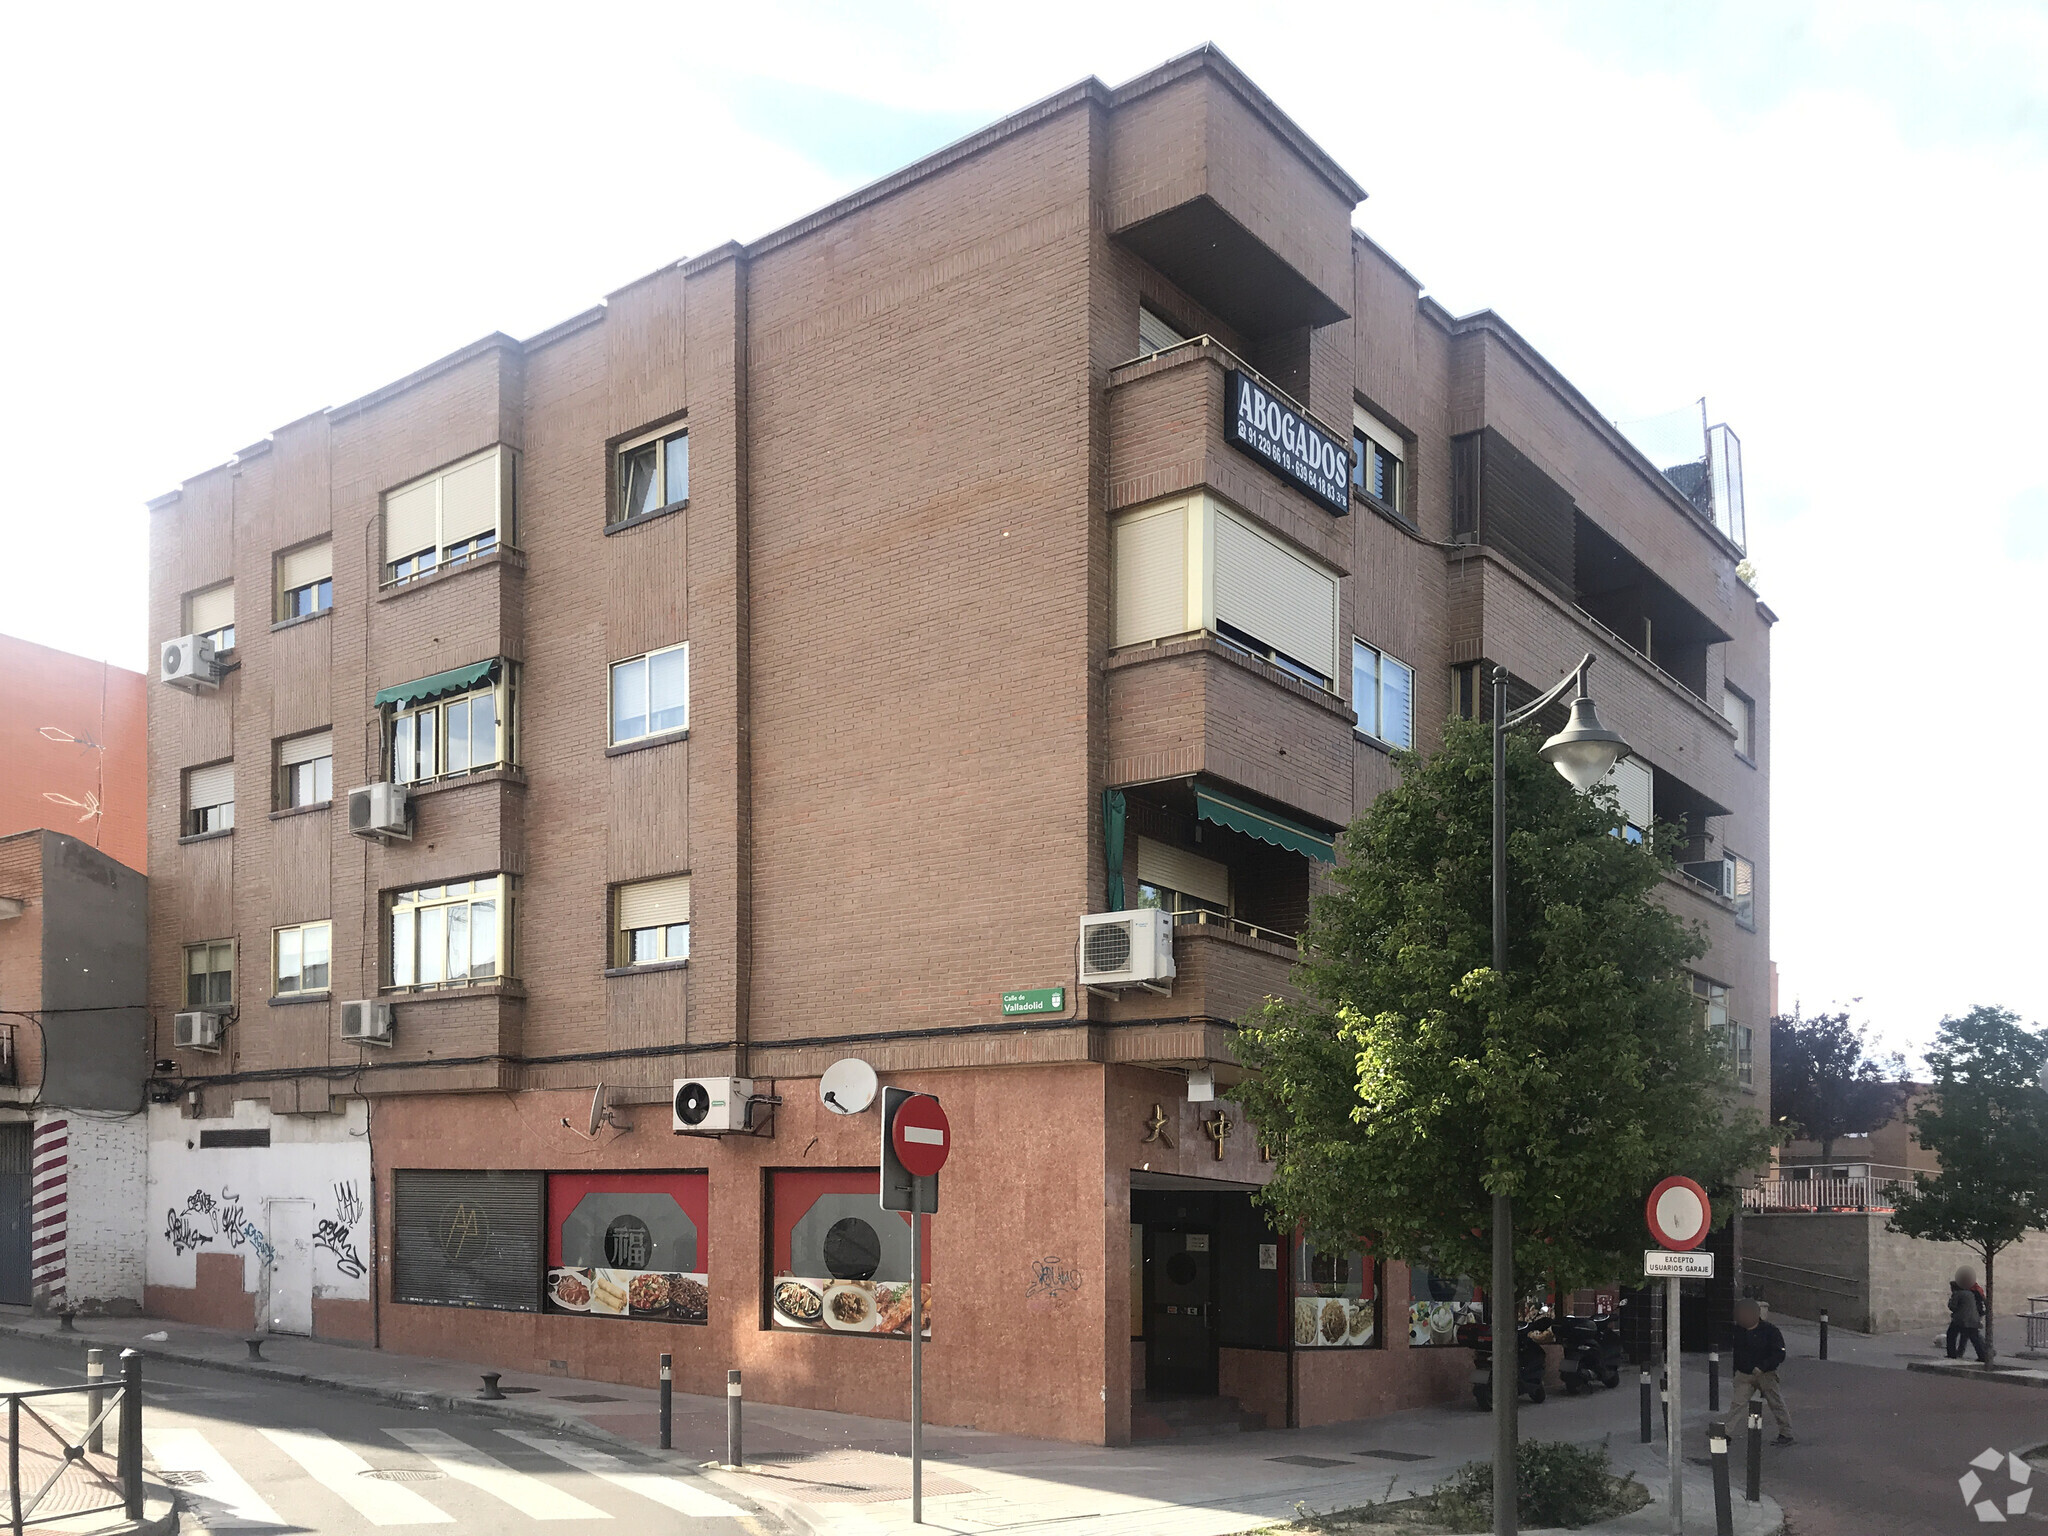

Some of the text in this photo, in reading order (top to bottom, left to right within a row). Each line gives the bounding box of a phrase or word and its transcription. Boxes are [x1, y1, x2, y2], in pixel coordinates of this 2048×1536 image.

[1239, 381, 1347, 488] ABOGADOS
[1248, 426, 1257, 447] 91
[1258, 434, 1271, 456] 229
[1282, 451, 1291, 470] 19
[1295, 460, 1308, 482] 639
[1308, 469, 1317, 489] 64
[1318, 476, 1326, 495] 18
[1327, 482, 1335, 501] 83
[1003, 994, 1018, 1002] Calle
[1003, 1000, 1044, 1012] Valladolid
[610, 1225, 646, 1267] 福
[1664, 1256, 1694, 1264] EXCEPTO
[1649, 1264, 1709, 1273] USUARIOS GARAJE
